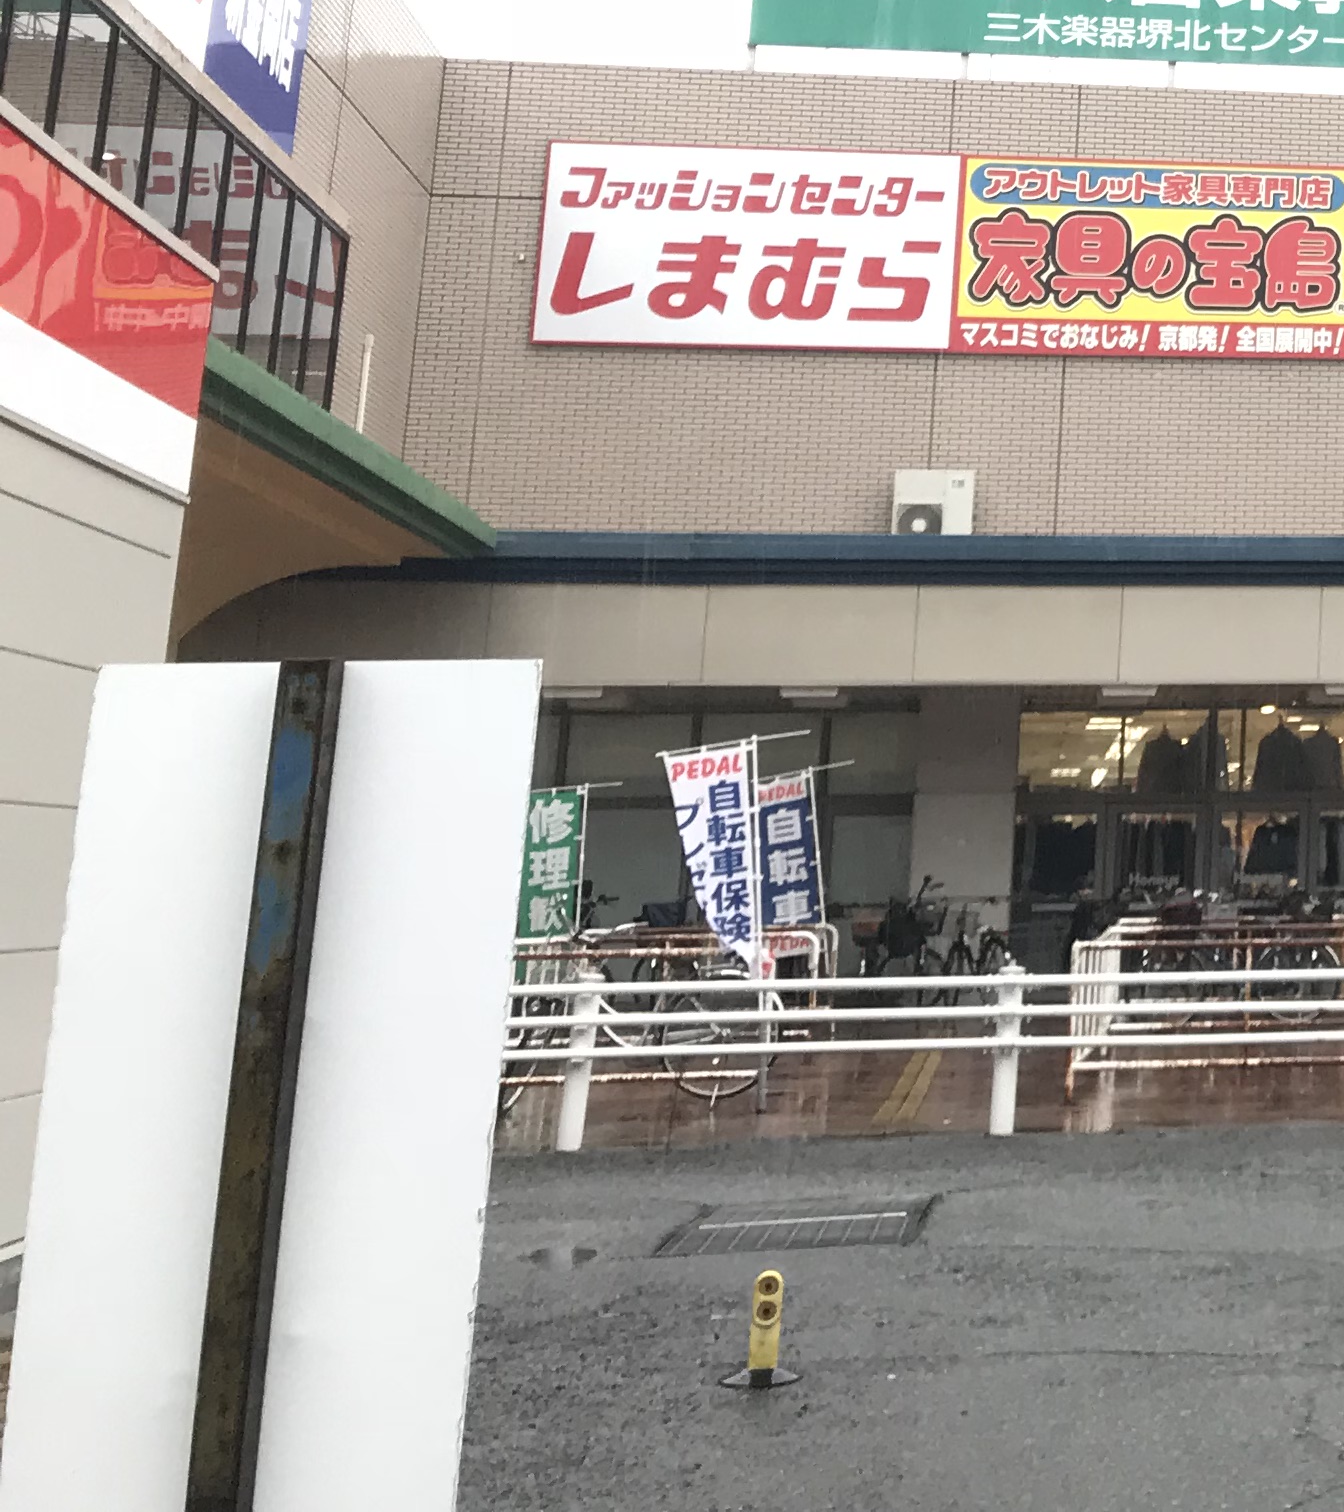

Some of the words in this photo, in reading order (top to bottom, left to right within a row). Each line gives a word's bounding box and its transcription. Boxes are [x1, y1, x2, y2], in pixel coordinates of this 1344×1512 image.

[559, 166, 946, 219] ファッションセンター
[982, 168, 1335, 210] アウトレット家具専門店
[548, 231, 943, 323] しまむら
[969, 206, 1342, 313] 家具の宝島
[671, 753, 743, 783] PEDAL
[706, 779, 753, 944] 自転車保険
[766, 807, 813, 925] 自転車
